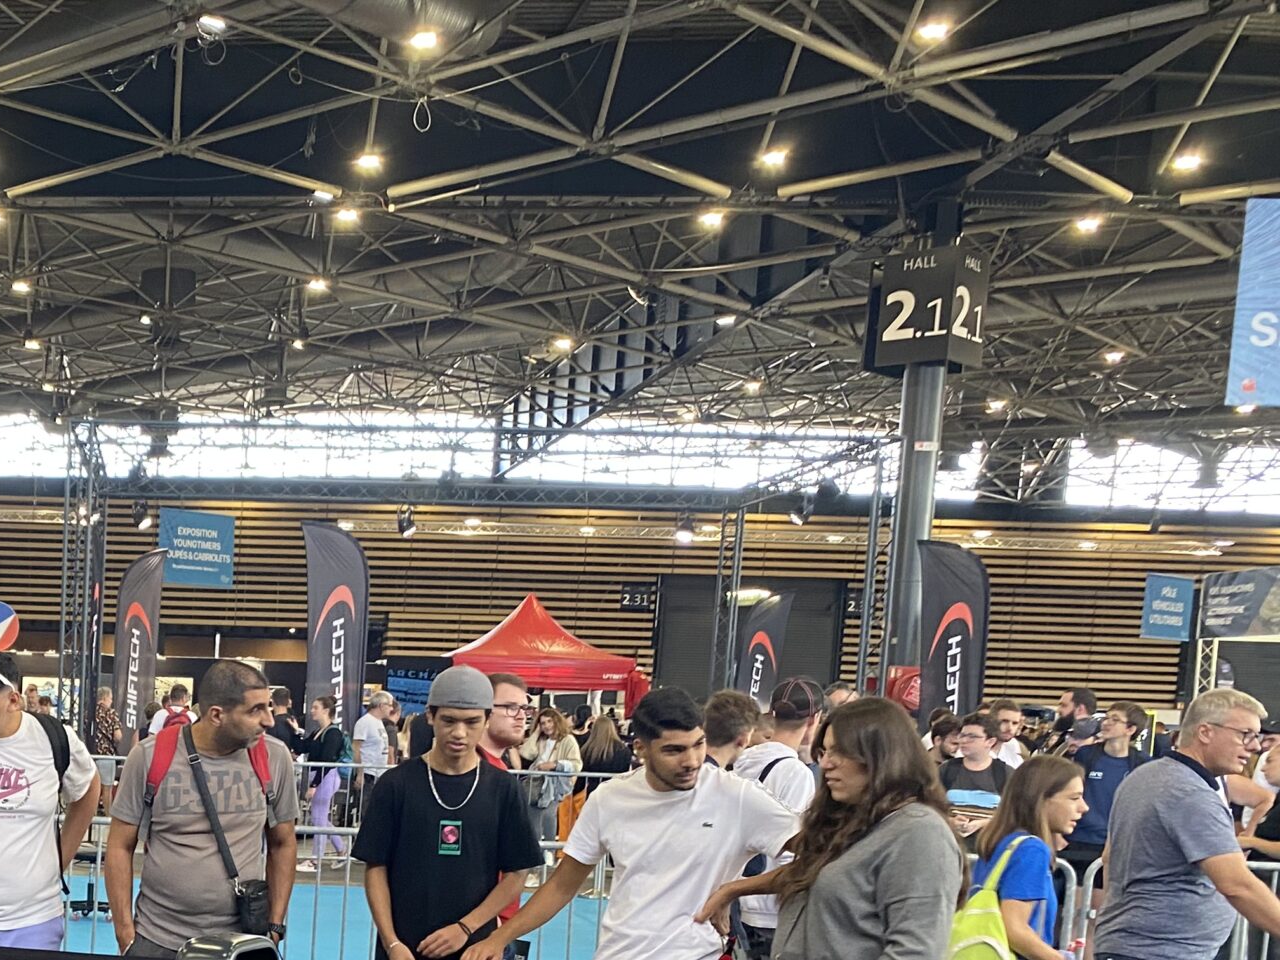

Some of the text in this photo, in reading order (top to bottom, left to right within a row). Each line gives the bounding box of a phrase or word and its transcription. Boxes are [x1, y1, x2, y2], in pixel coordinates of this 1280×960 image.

[903, 255, 937, 271] HALL
[965, 254, 981, 273] HALL
[882, 290, 947, 341] 2.1
[951, 285, 983, 343] 2.1
[1249, 311, 1280, 347] S
[177, 526, 218, 539] EXPOSITION
[173, 538, 222, 551] YOUNGTIMERS
[622, 594, 649, 606] 2.31
[126, 628, 140, 731] SHIFTECH
